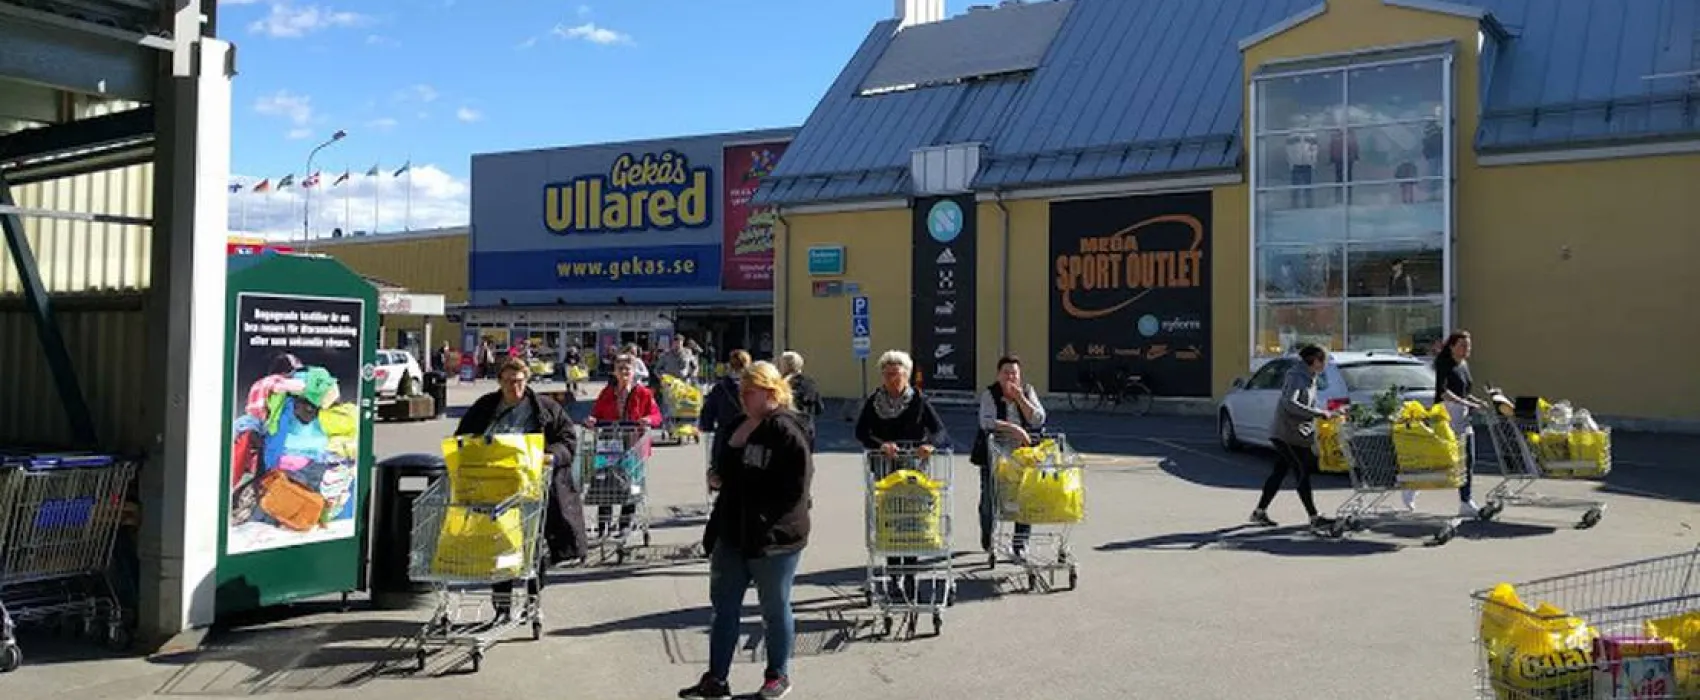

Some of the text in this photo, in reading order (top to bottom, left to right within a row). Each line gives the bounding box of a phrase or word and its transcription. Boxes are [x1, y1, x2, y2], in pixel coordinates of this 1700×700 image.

[611, 152, 687, 188] Gekås
[545, 170, 707, 231] Ullared
[1079, 235, 1139, 252] MEGA
[556, 255, 695, 281] www.gekas.se
[1055, 249, 1203, 291] SPORT OUTLET
[855, 298, 866, 315] P
